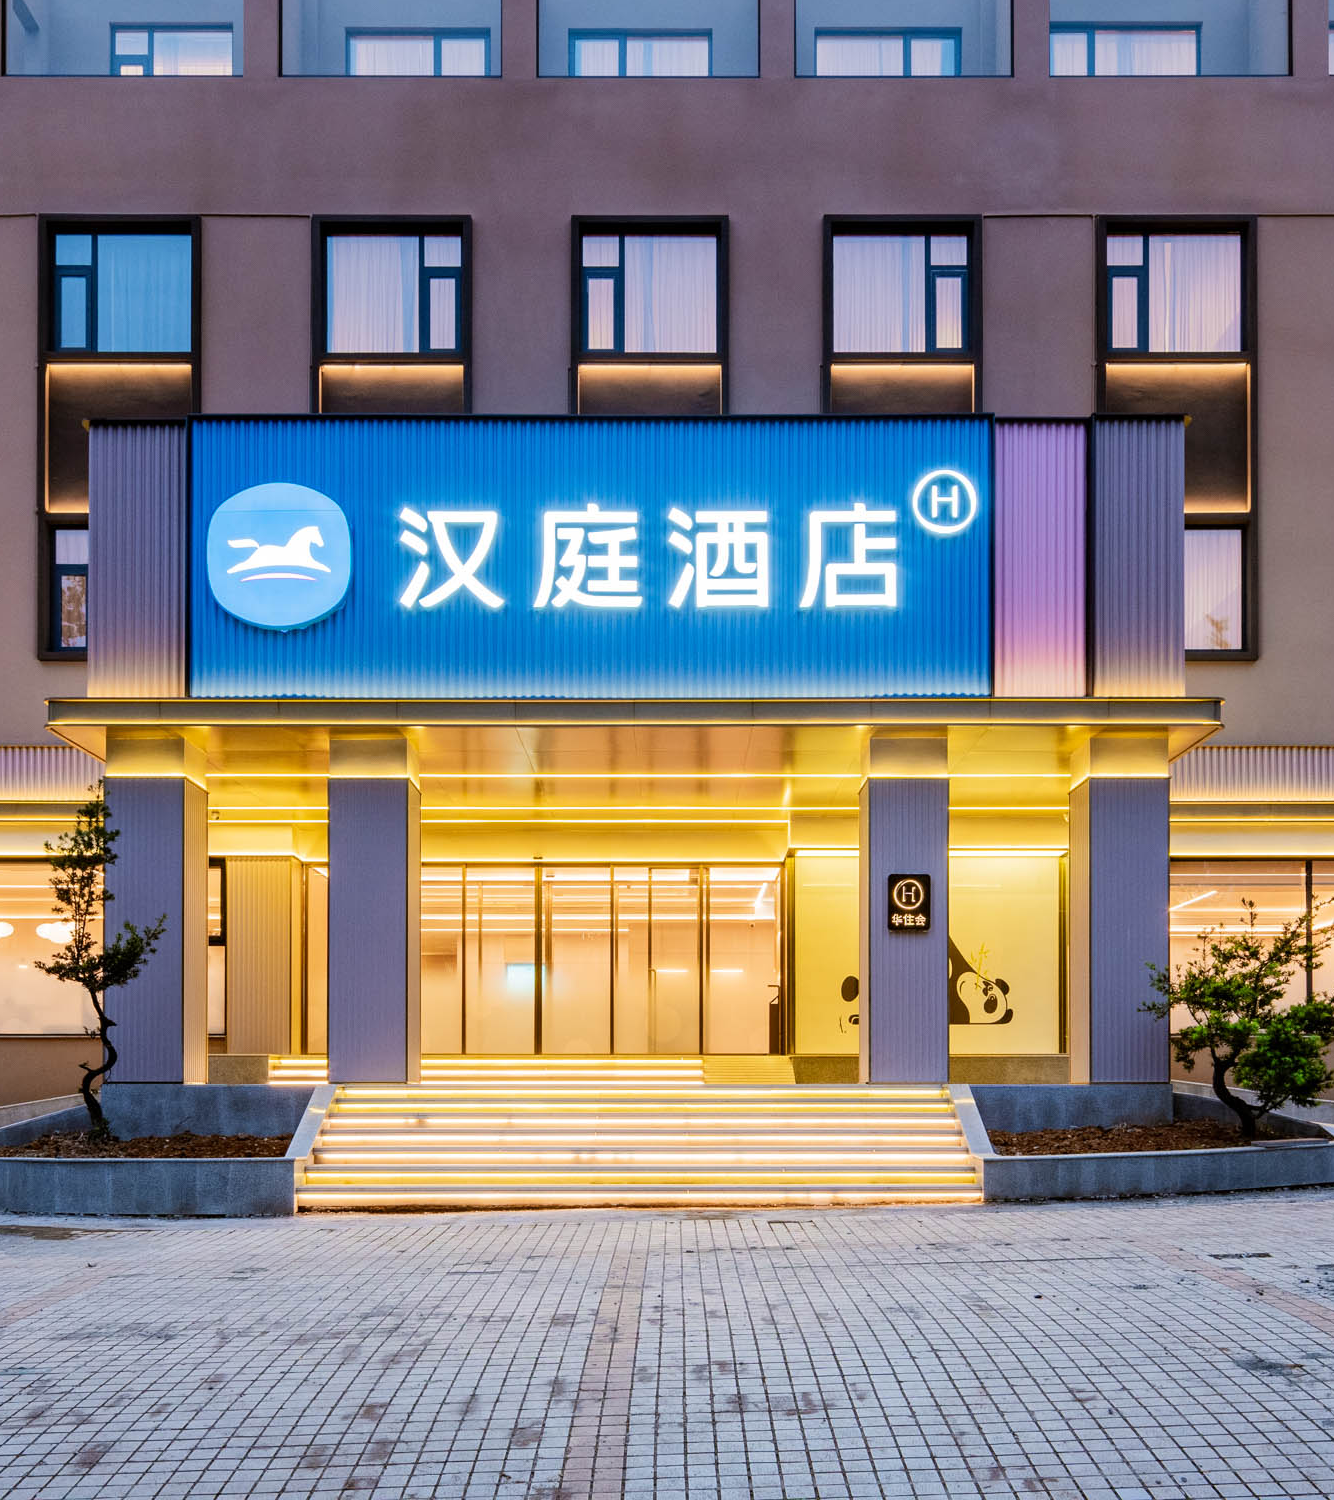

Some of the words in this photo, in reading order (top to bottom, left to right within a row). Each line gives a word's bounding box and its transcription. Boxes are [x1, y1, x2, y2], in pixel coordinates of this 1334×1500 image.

[397, 501, 900, 610] 汉庭酒店
[891, 913, 926, 926] 华住会
